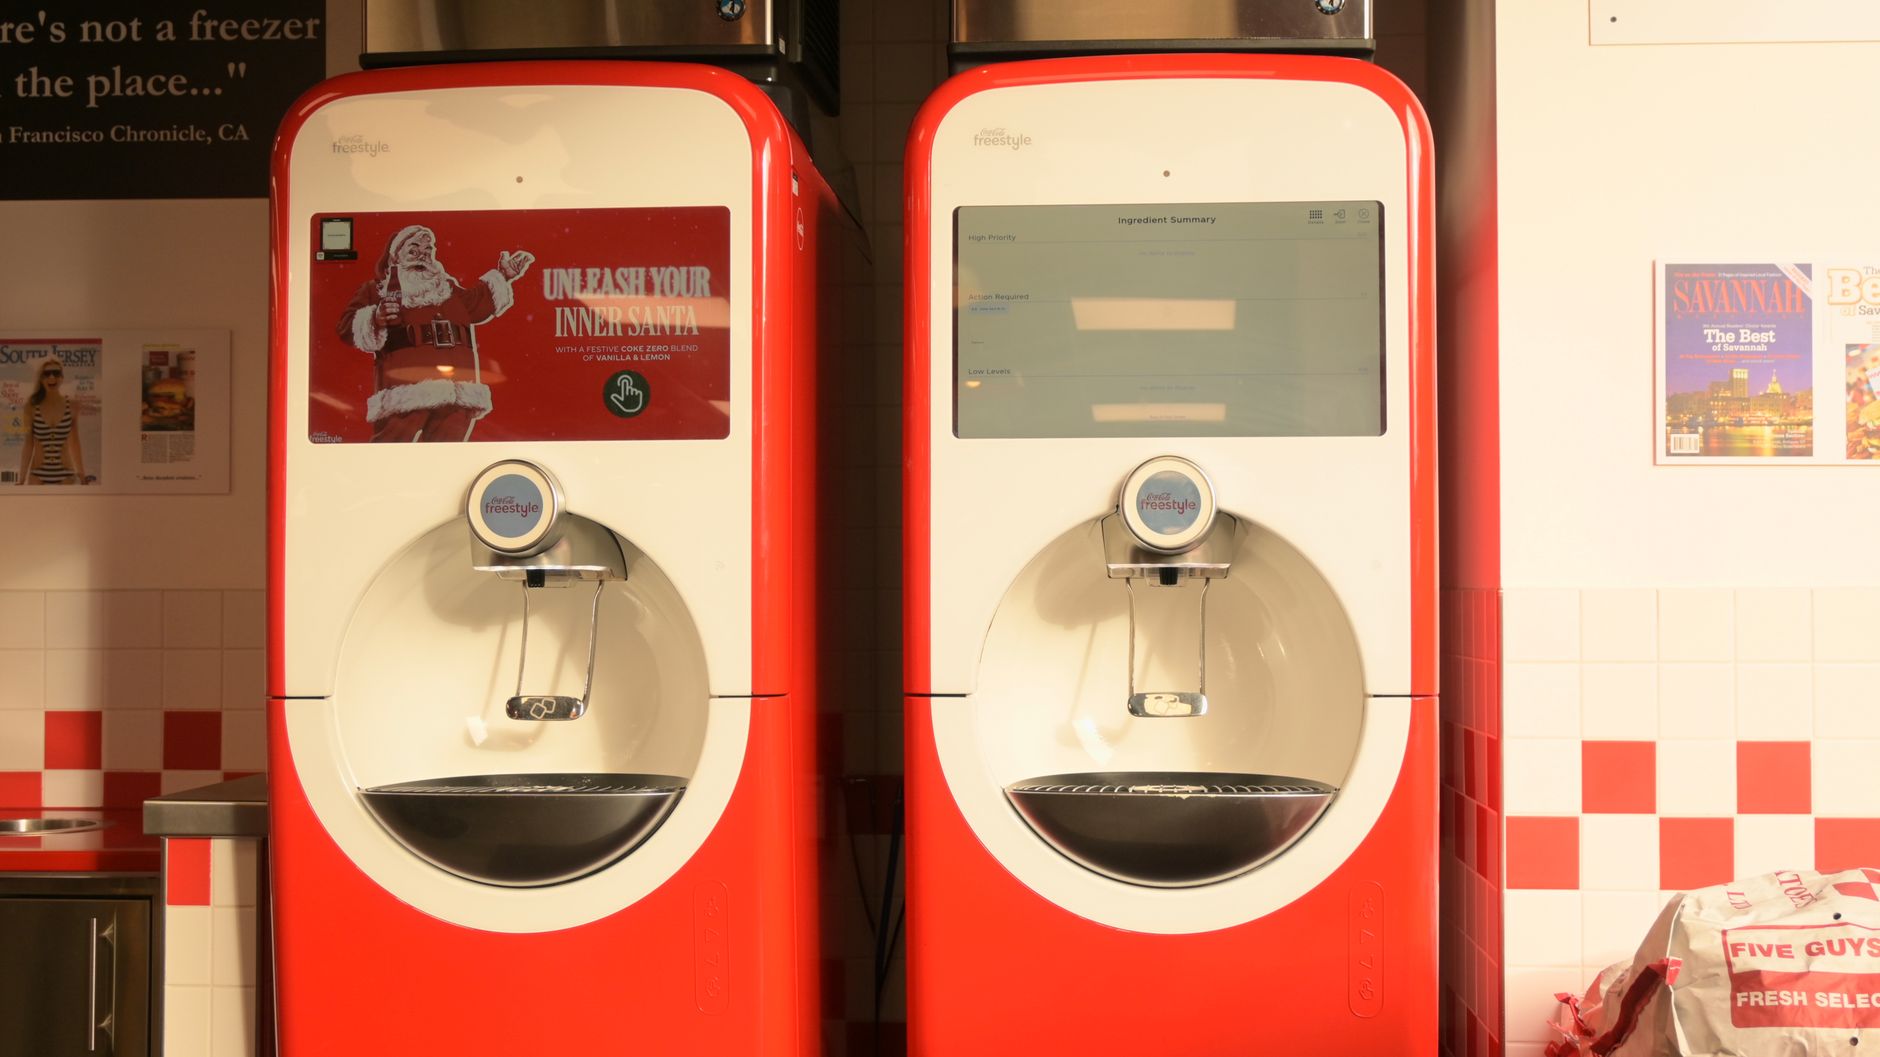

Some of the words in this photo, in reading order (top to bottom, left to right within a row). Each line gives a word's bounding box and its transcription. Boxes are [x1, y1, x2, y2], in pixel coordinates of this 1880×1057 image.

[0, 10, 66, 43] re's
[79, 18, 142, 42] not
[156, 20, 176, 42] a
[189, 9, 321, 41] freezer
[15, 66, 74, 98] the
[9, 125, 104, 143] Francisco
[110, 124, 212, 144] Chronicle,
[218, 123, 249, 141] CA
[332, 140, 391, 157] freestyle
[974, 134, 1032, 151] freestyle
[1118, 216, 1167, 225] Ingredient
[1170, 216, 1216, 225] Summary
[968, 234, 986, 242] High
[988, 234, 1017, 242] Priority
[543, 267, 646, 300] UNLEASH
[650, 266, 712, 298] YOUR
[968, 293, 993, 301] Action
[995, 293, 1030, 302] Required
[1673, 279, 1806, 313] SAVANNAH
[555, 306, 623, 337] INNER
[628, 305, 700, 337] SANTA
[1703, 328, 1736, 343] The
[1739, 328, 1776, 343] Best
[586, 345, 620, 353] FESTIVE
[671, 344, 699, 352] BLEND
[1712, 343, 1722, 351] of
[1723, 343, 1768, 351] Savannah
[583, 354, 595, 362] OF
[640, 353, 671, 361] LEMON
[485, 502, 539, 518] freestyle
[1140, 499, 1196, 515] freestyle
[1729, 942, 1795, 959] FIVE
[1804, 938, 1880, 957] GUYS
[1736, 990, 1809, 1007] FRESH
[1814, 991, 1880, 1009] SELEC
